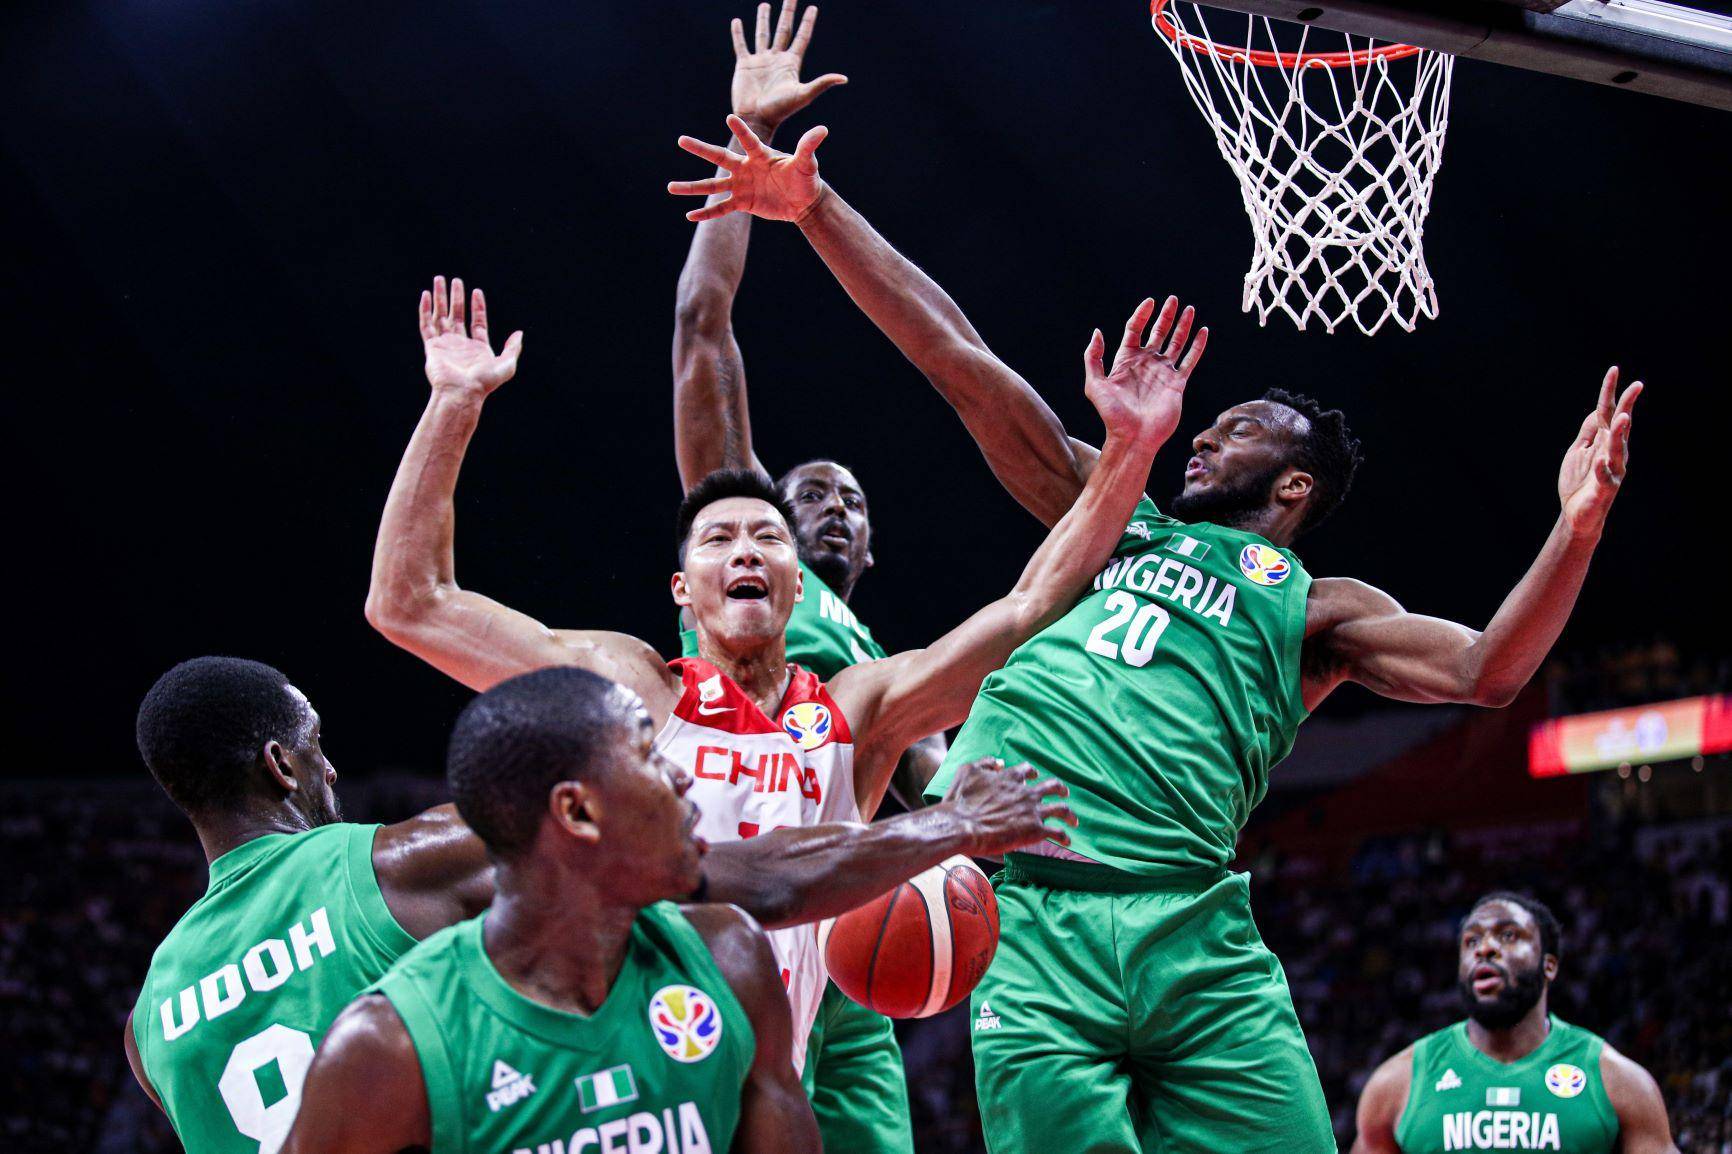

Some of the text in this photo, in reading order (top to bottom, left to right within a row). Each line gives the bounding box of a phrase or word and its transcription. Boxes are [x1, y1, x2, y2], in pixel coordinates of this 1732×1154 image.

[1094, 554, 1237, 627] NIGERIA
[1085, 590, 1170, 668] 20
[694, 745, 822, 806] CHINA
[160, 906, 336, 1041] UDOH
[975, 1016, 1002, 1031] PEAK
[1442, 1110, 1561, 1151] NIGERIA
